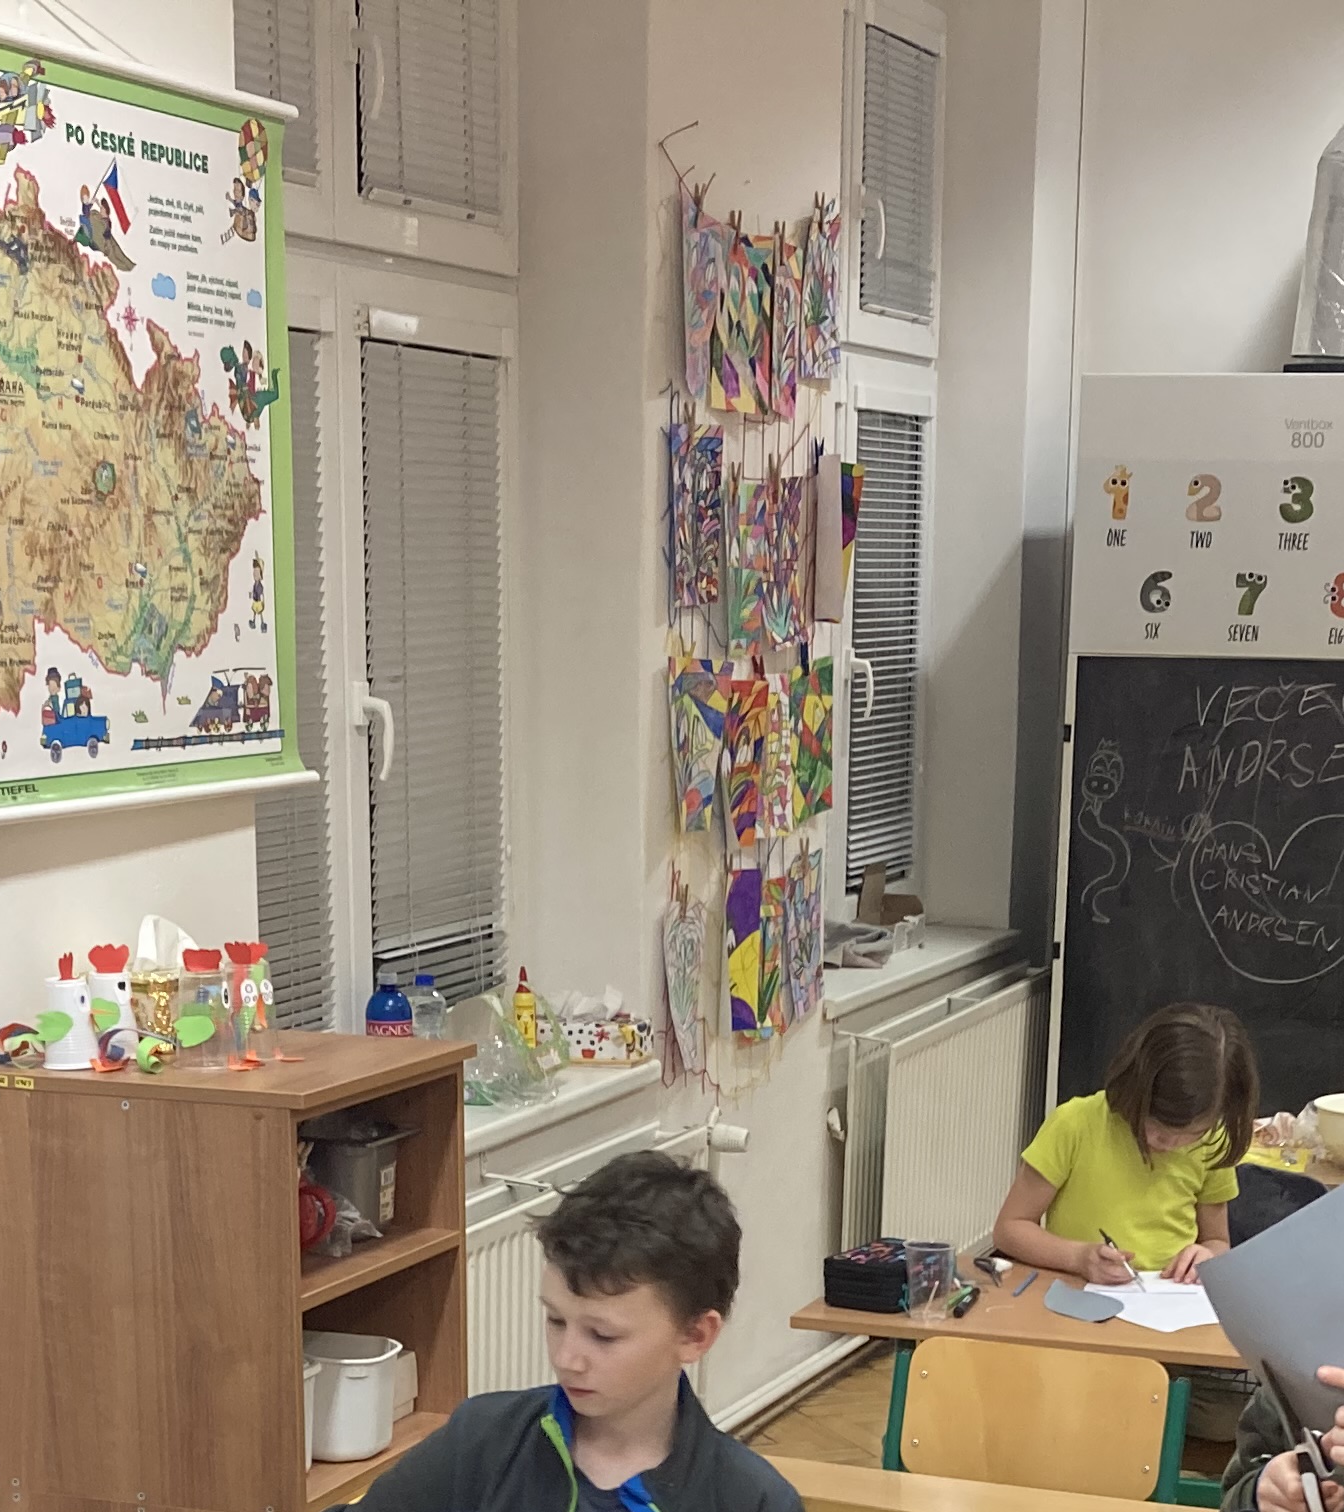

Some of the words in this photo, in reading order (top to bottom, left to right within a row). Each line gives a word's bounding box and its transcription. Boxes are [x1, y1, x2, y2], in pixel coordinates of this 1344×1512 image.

[65, 123, 85, 145] PO
[91, 124, 135, 157] ČESKÉ
[141, 140, 209, 174] REPUBLICE
[1284, 417, 1333, 430] Ventbox
[1291, 431, 1325, 449] 800
[1106, 528, 1127, 548] ONE
[1189, 530, 1213, 550] TWO
[1278, 532, 1310, 552] THREE
[1144, 622, 1160, 640] SIX
[1227, 623, 1260, 643] SEVEN
[1200, 841, 1262, 864] HANS
[1200, 869, 1327, 903] CRISTIAN
[1212, 905, 1341, 952] ANDRSEN
[366, 1023, 411, 1036] MAGNES
